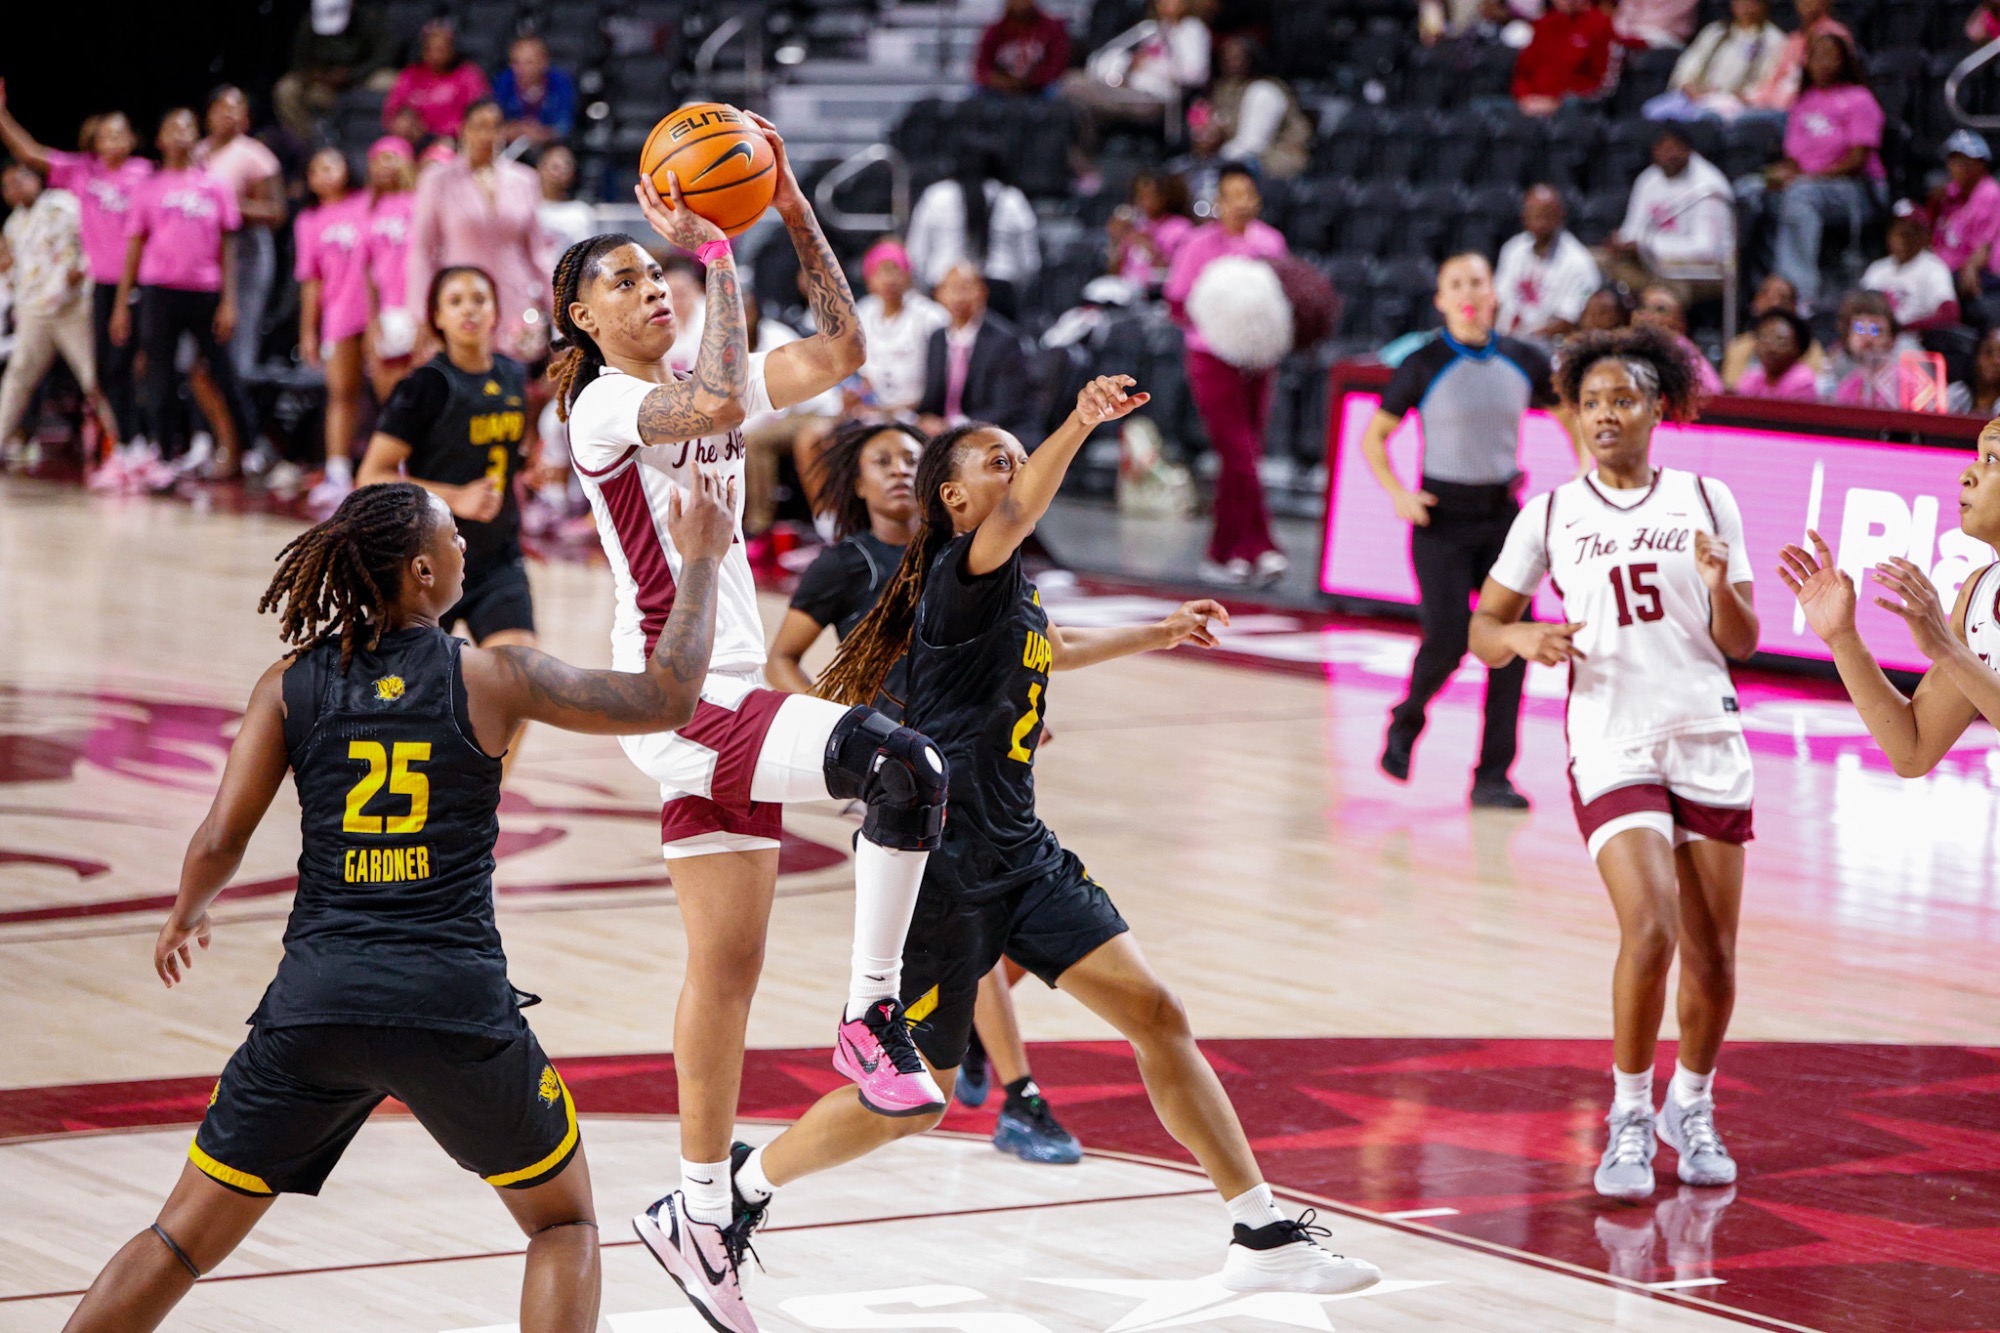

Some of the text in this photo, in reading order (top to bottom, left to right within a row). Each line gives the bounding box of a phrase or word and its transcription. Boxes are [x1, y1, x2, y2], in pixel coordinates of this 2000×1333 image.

[669, 110, 742, 143] ELITE
[1575, 527, 1689, 565] The Hill
[1609, 563, 1665, 627] 15
[343, 740, 432, 834] 25
[344, 846, 430, 883] GARDNER
